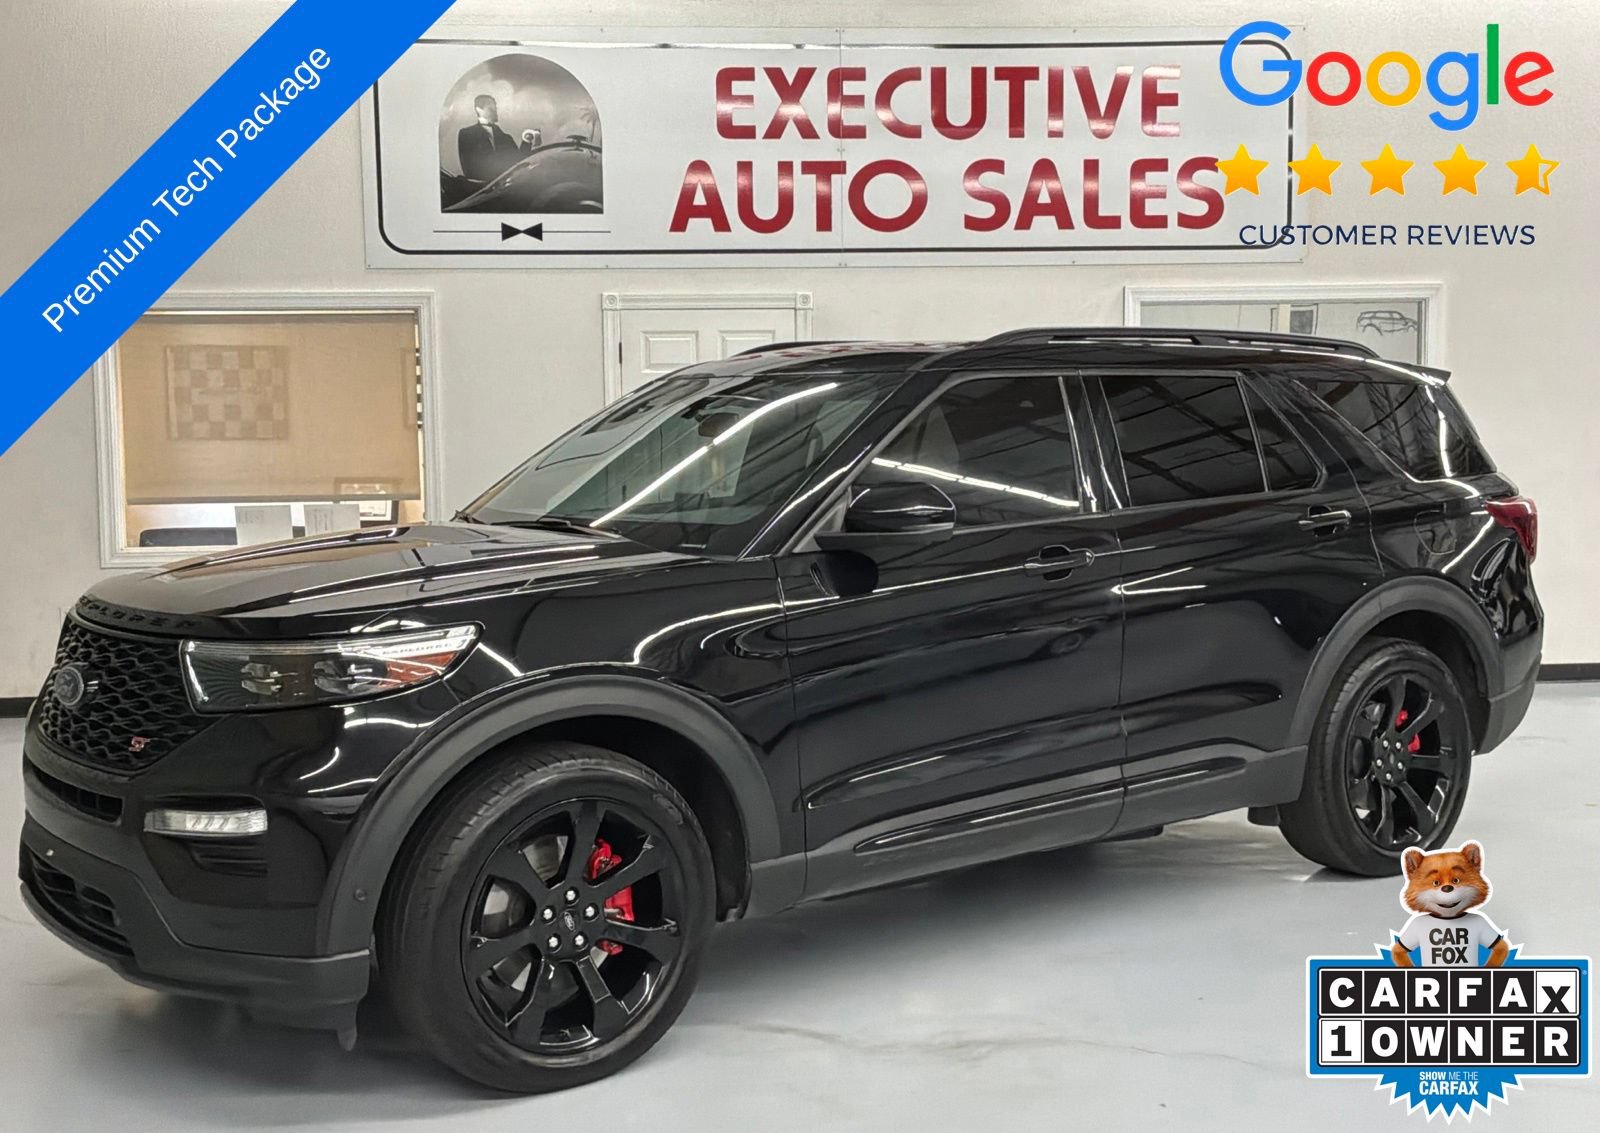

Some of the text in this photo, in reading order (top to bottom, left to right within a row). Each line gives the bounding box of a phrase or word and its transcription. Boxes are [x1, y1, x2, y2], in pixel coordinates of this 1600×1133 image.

[715, 65, 1182, 141] EXECUTIVE
[669, 156, 1226, 234] AUTO SALES
